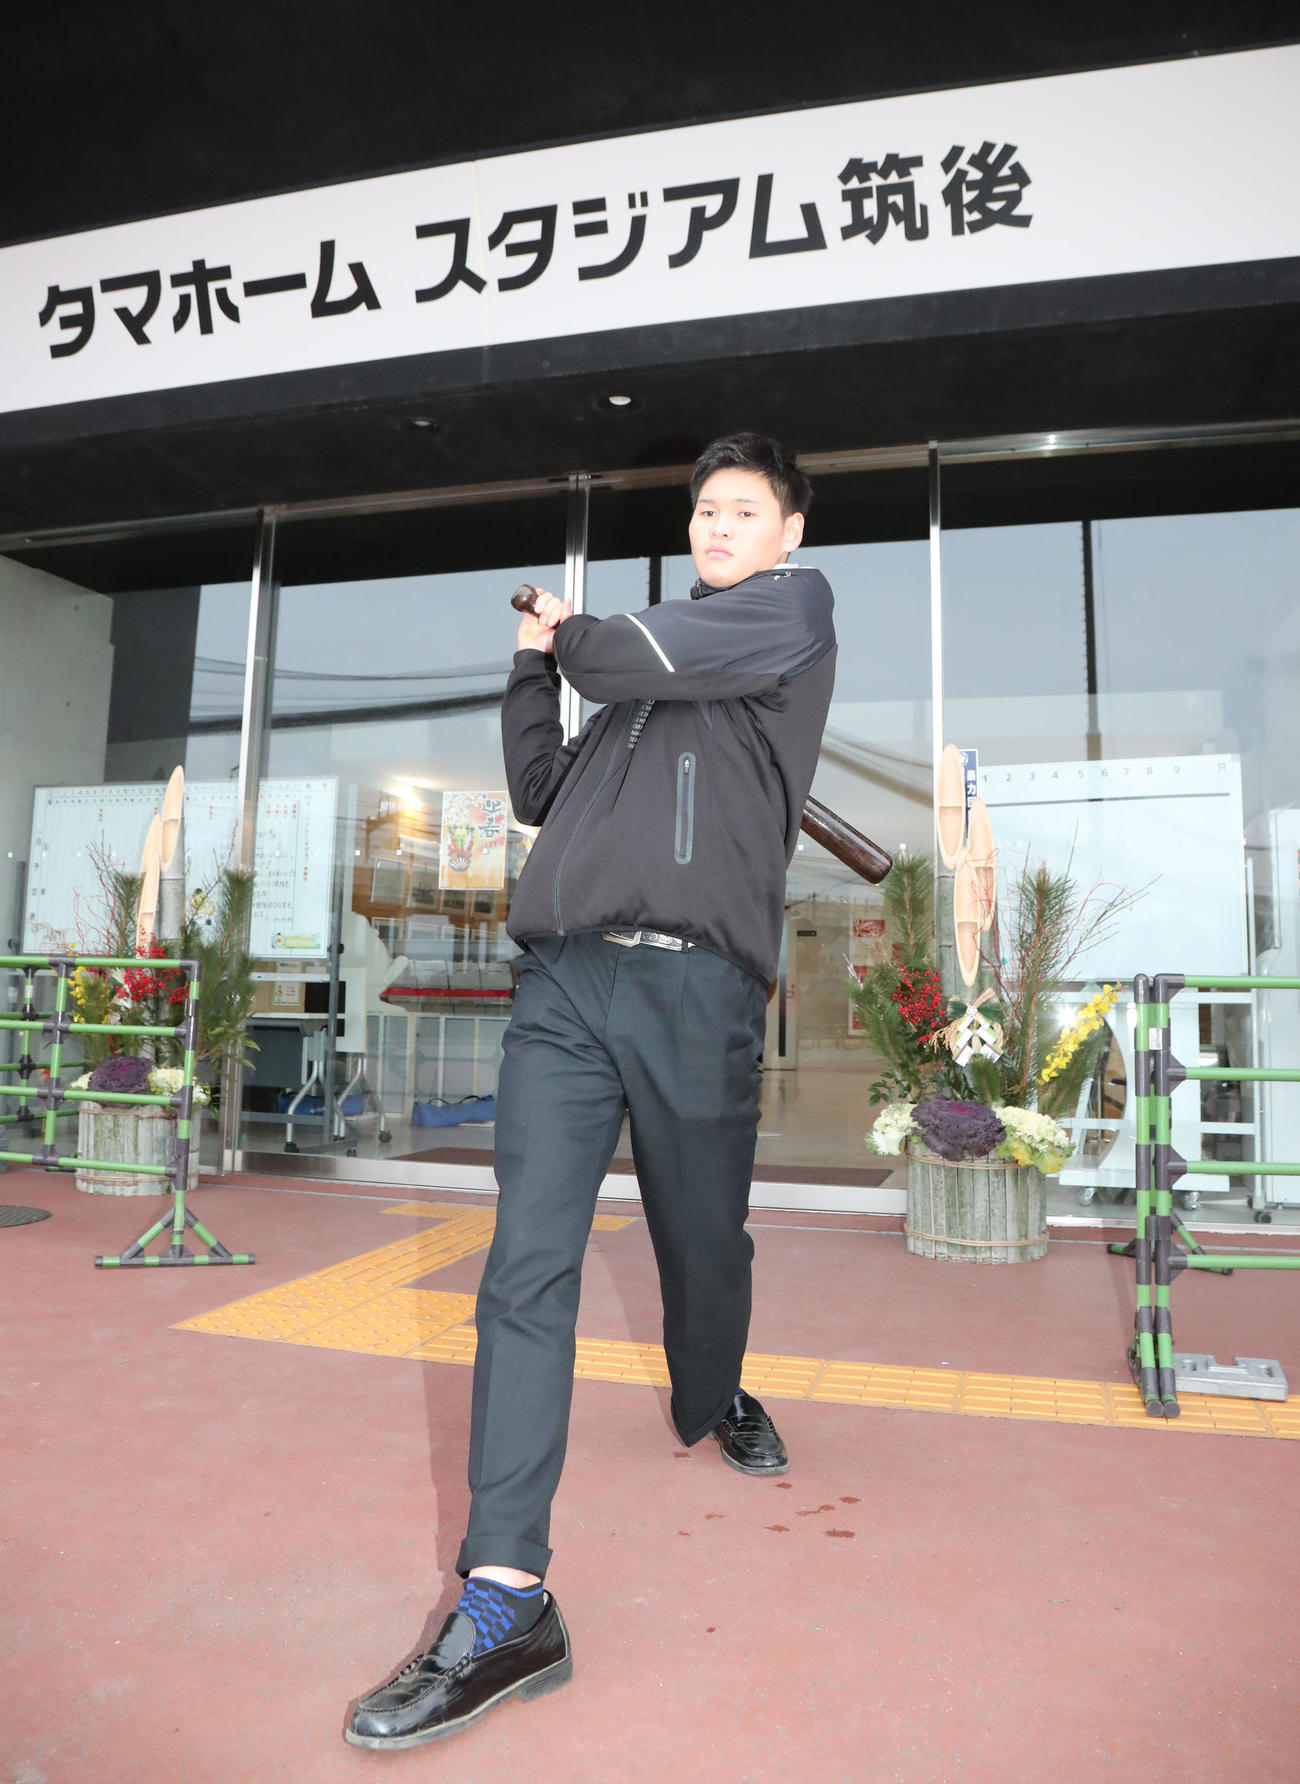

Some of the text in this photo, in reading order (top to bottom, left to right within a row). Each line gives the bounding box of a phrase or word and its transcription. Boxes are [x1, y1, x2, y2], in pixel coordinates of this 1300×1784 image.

[38, 141, 1033, 359] タマホーム スタジアム筑後
[982, 774, 988, 783] 1
[1005, 773, 1012, 782] 2
[1029, 771, 1036, 781] 3
[1051, 770, 1059, 779] 4
[1101, 768, 1109, 777] 6
[1123, 767, 1130, 776] 7
[1172, 765, 1180, 775] 9
[1218, 762, 1227, 773] R
